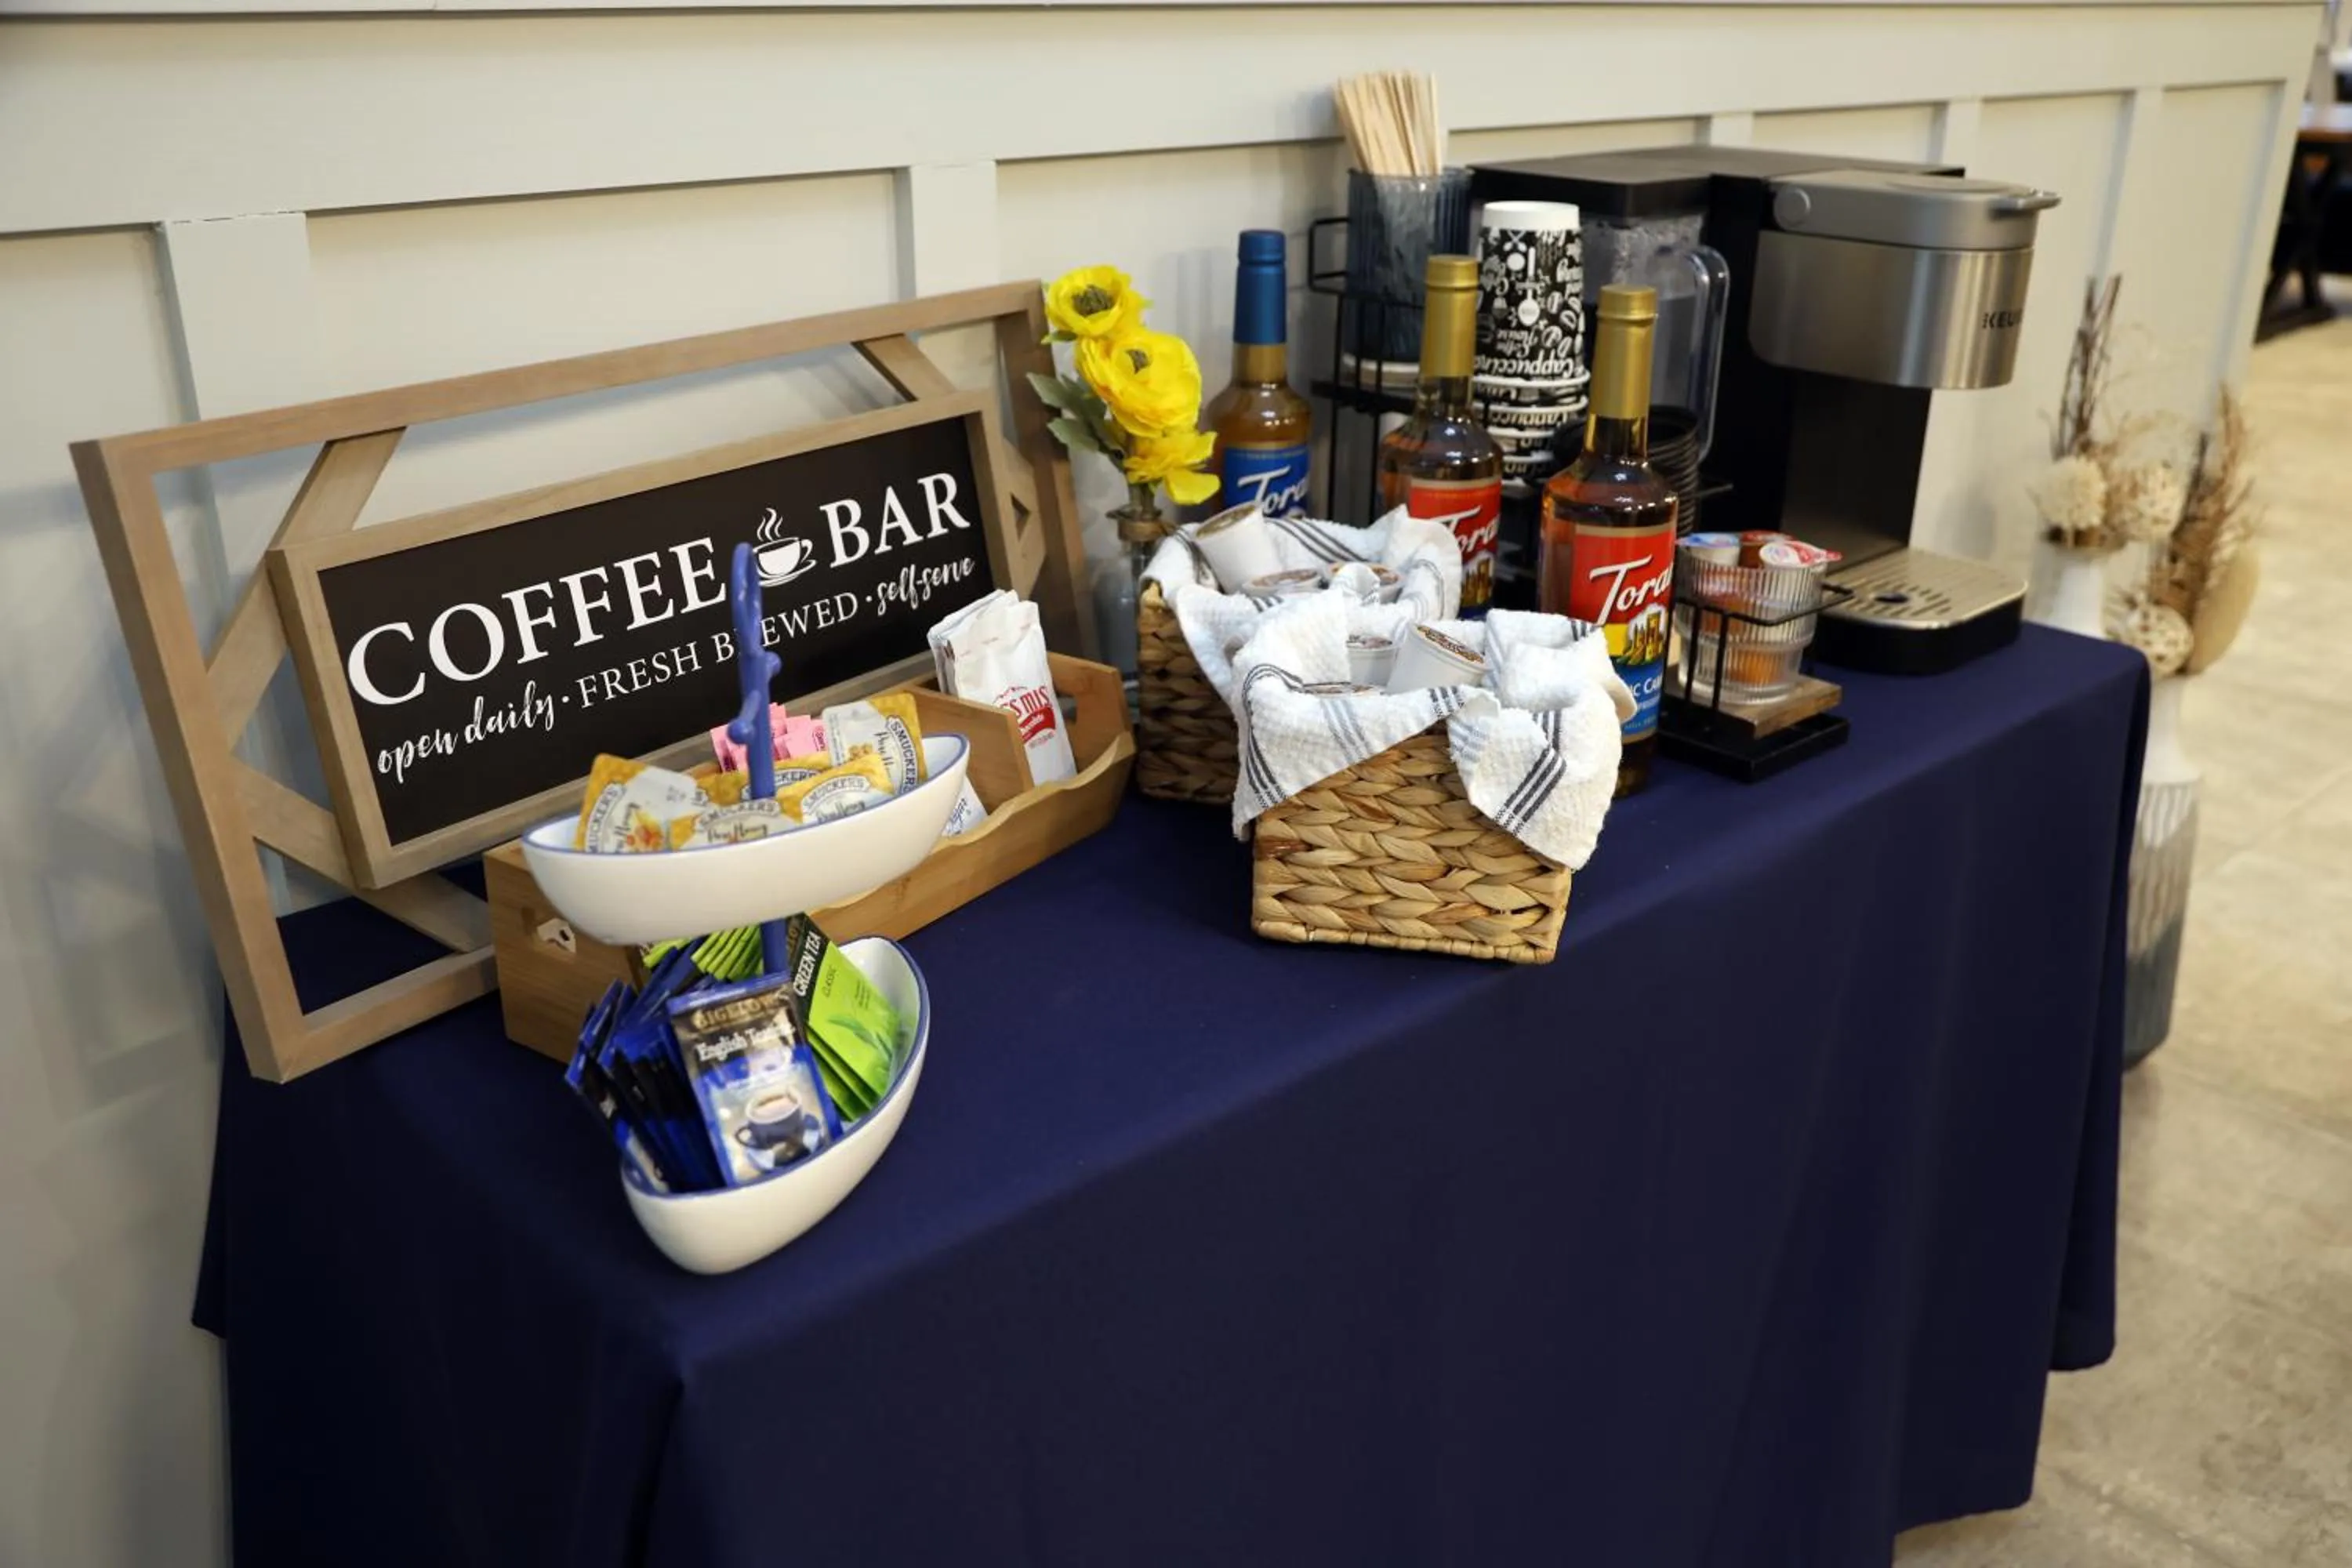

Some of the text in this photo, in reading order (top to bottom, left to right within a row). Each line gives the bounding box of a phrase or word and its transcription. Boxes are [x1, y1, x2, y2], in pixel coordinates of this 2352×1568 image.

[1237, 464, 1308, 514] Tora
[1428, 505, 1500, 552] Tora
[347, 472, 971, 705] COFFEE BAR
[1588, 554, 1673, 626] Tora
[377, 557, 975, 783] open daily FRESH BEWED self-serve
[792, 952, 817, 997] GREEN
[805, 930, 823, 956] TEA
